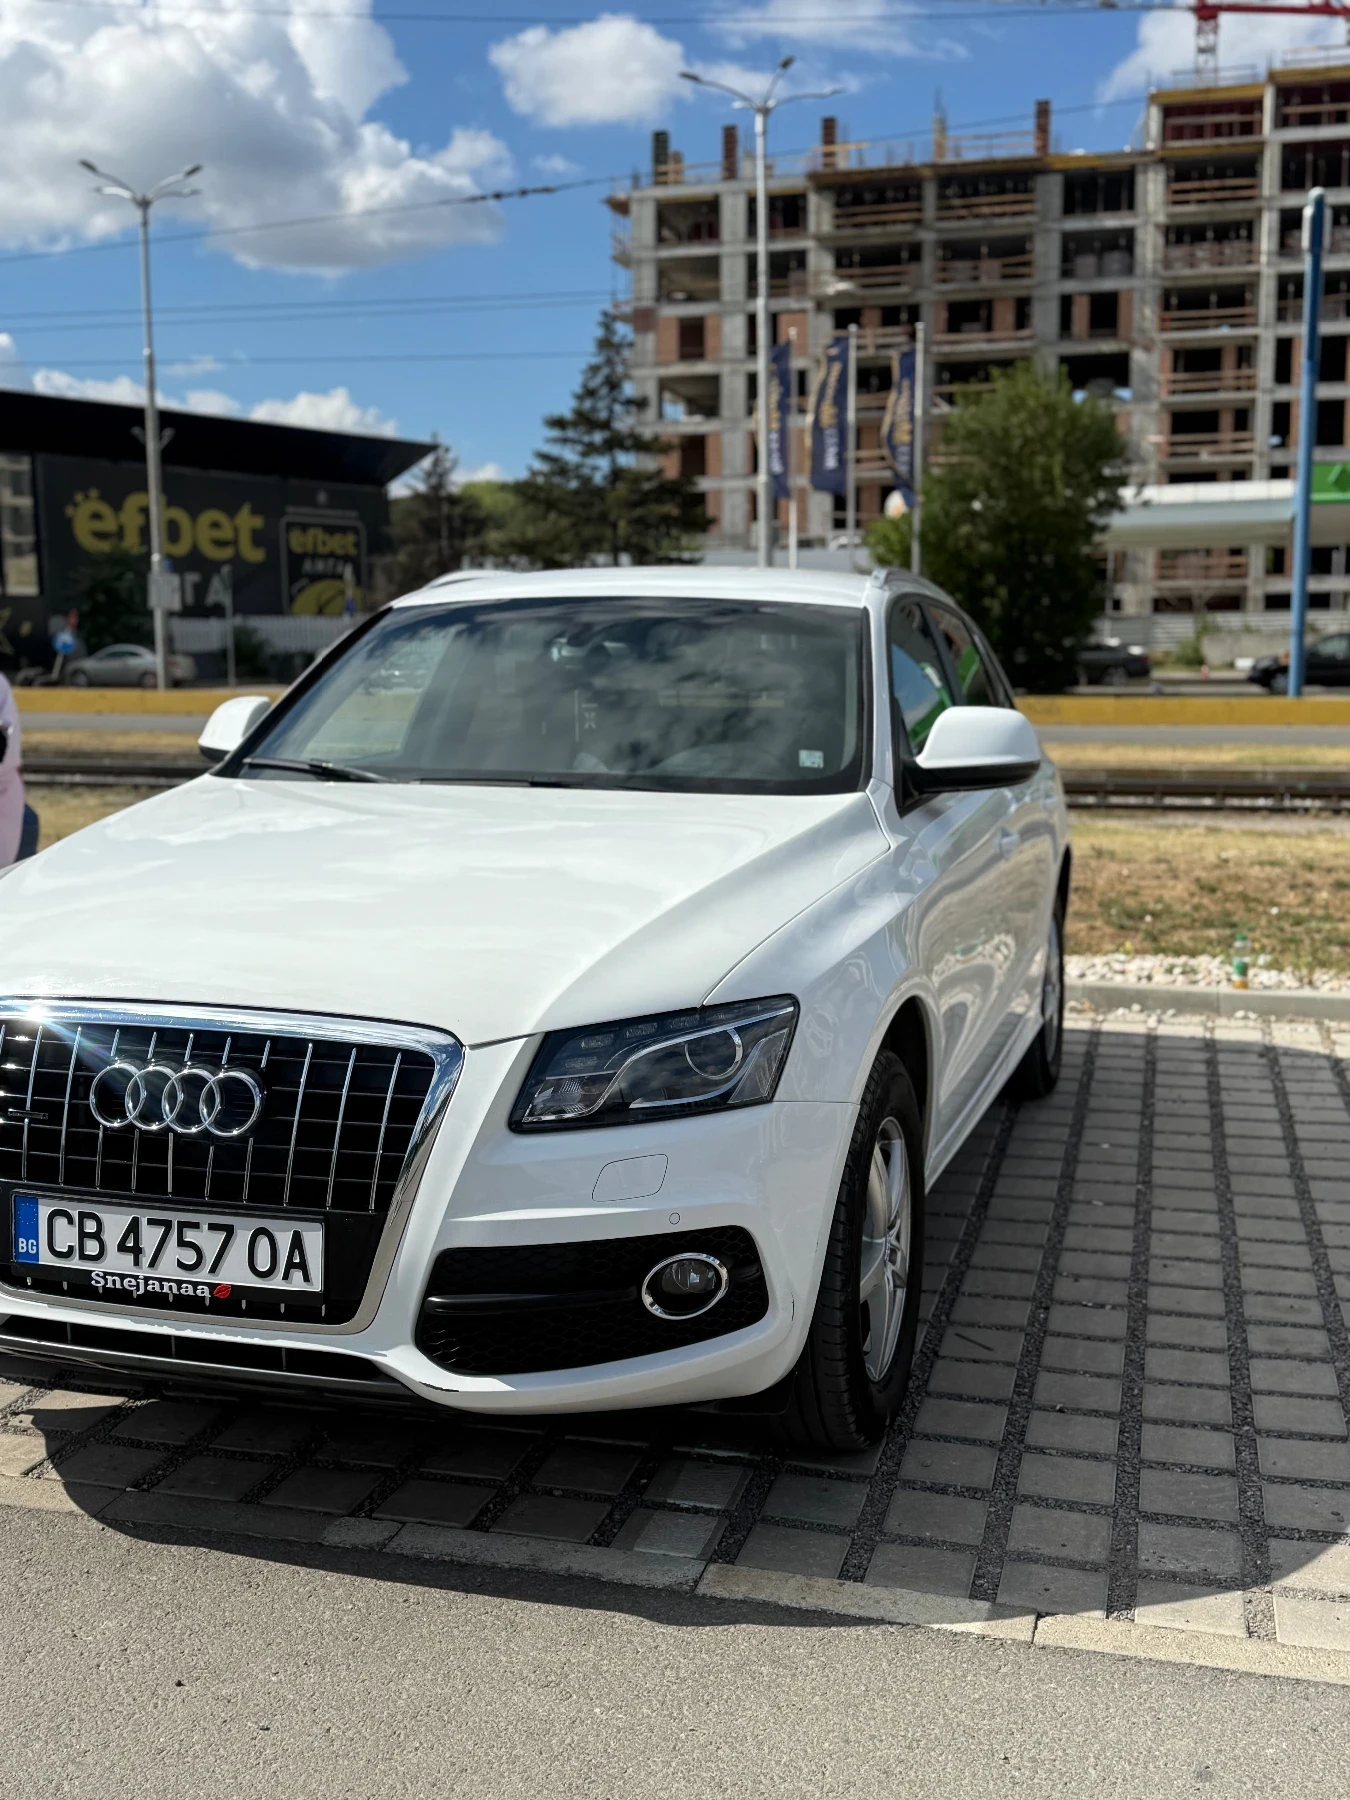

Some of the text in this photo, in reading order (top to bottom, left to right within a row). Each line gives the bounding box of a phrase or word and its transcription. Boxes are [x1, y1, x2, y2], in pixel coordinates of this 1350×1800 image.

[66, 488, 266, 563] efbet
[18, 1237, 37, 1255] BG
[46, 1208, 105, 1262] CB
[116, 1216, 236, 1275] 4757
[90, 1270, 211, 1299] Snejanaa
